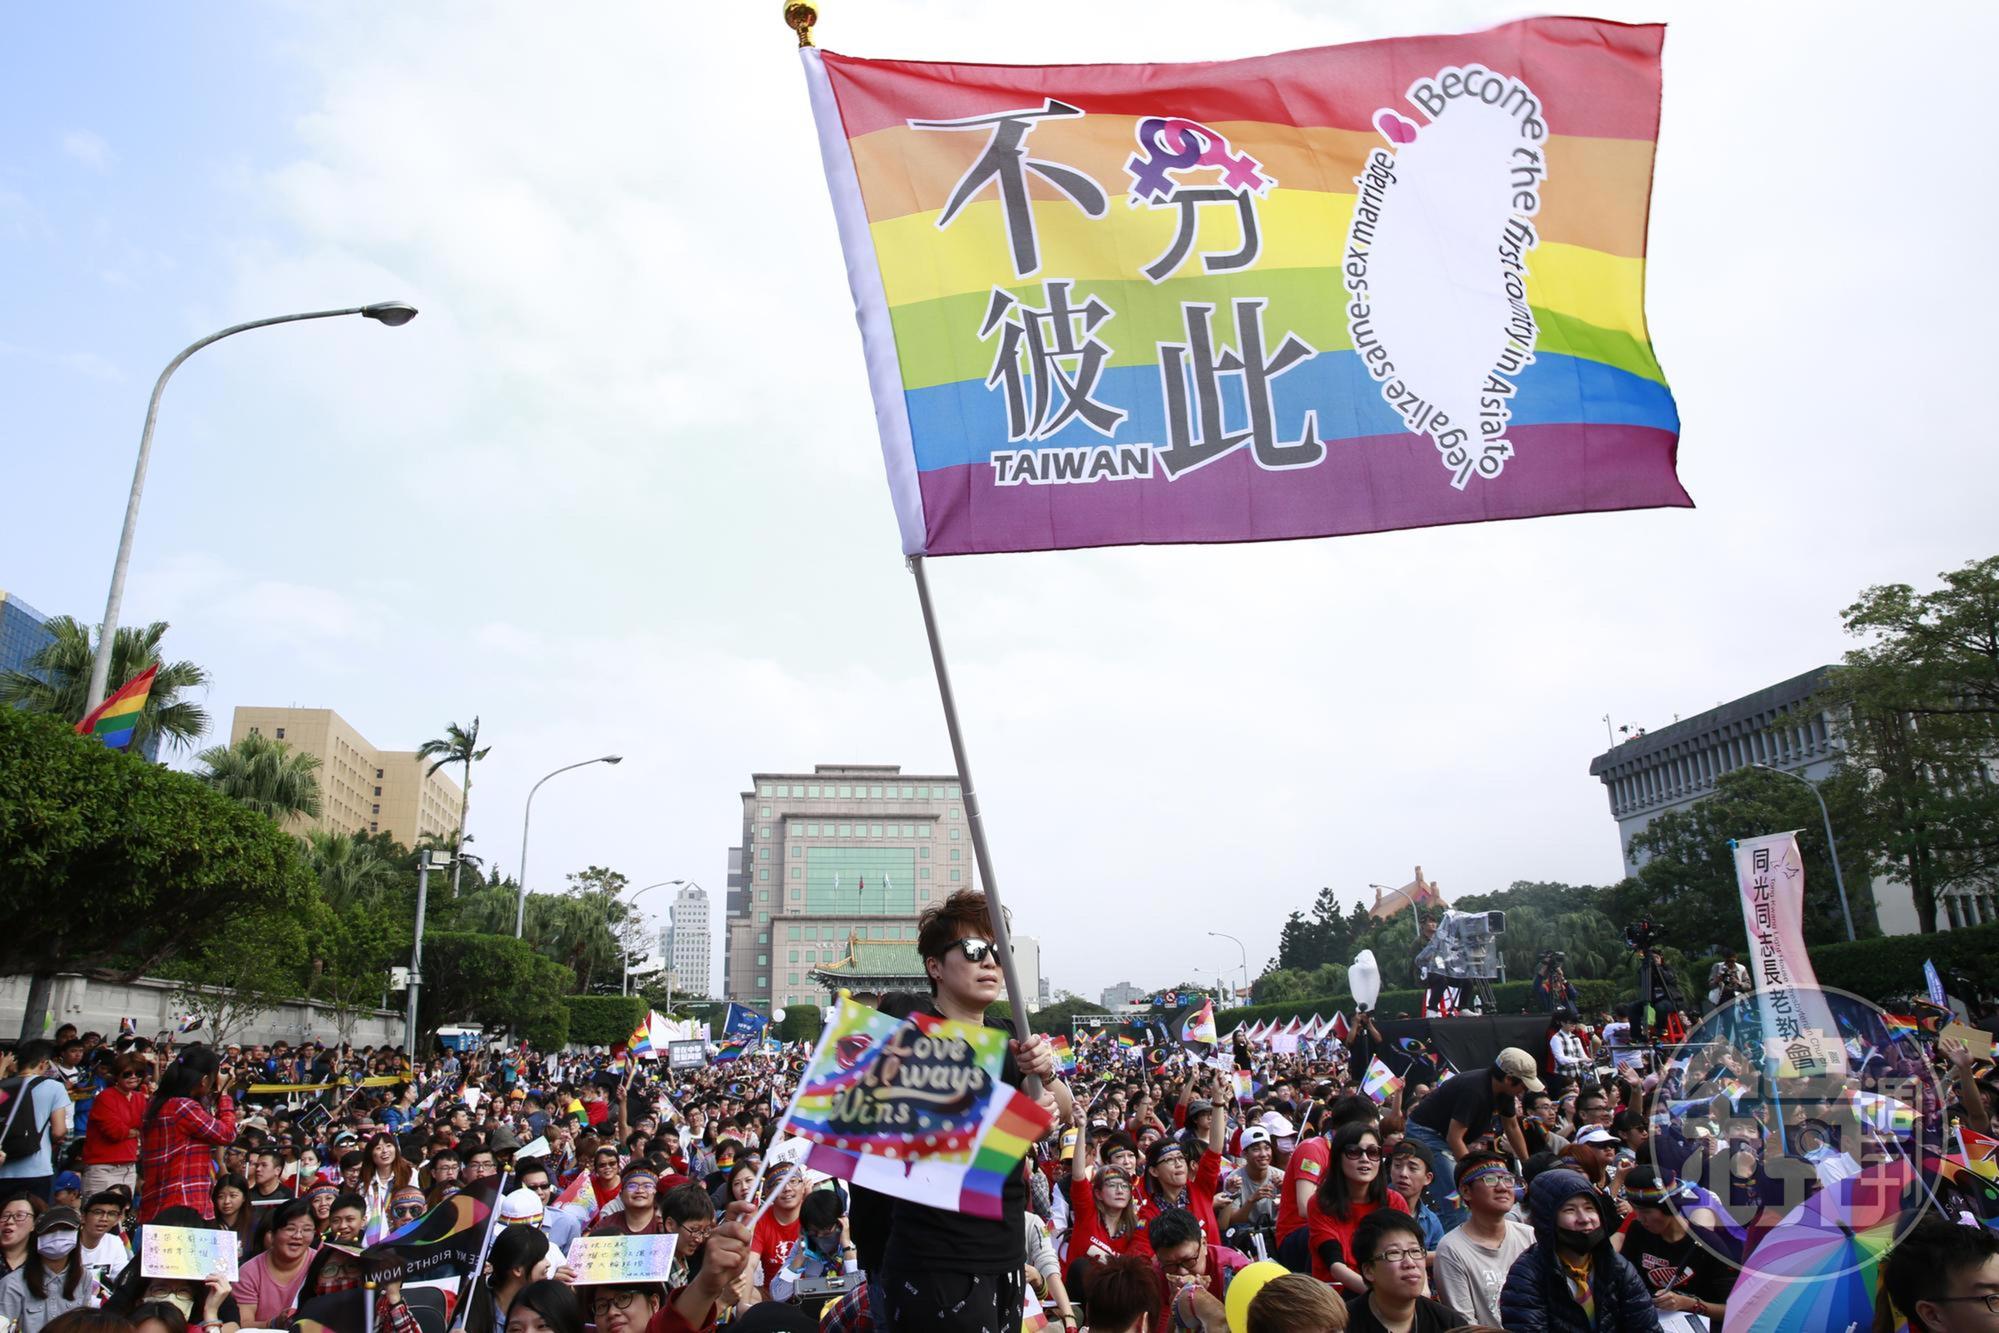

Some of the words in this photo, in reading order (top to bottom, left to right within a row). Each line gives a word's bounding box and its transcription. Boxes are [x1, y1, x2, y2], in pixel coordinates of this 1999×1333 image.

[1413, 69, 1544, 141] Become
[908, 98, 1276, 281] 不分
[1352, 151, 1398, 246] marriage
[1511, 147, 1542, 212] the
[1499, 218, 1535, 272] first
[1346, 246, 1395, 378] same-sex
[1504, 271, 1535, 347] country
[980, 282, 1324, 483] 彼此
[1496, 347, 1532, 373] in
[1386, 379, 1473, 485] legalize
[1479, 375, 1512, 442] Asia
[994, 446, 1150, 483] TAIWAN
[1479, 443, 1509, 475] to
[1752, 847, 1815, 1071] 同光同志長老教會
[884, 1020, 968, 1062] Love
[828, 1085, 911, 1126] Wins
